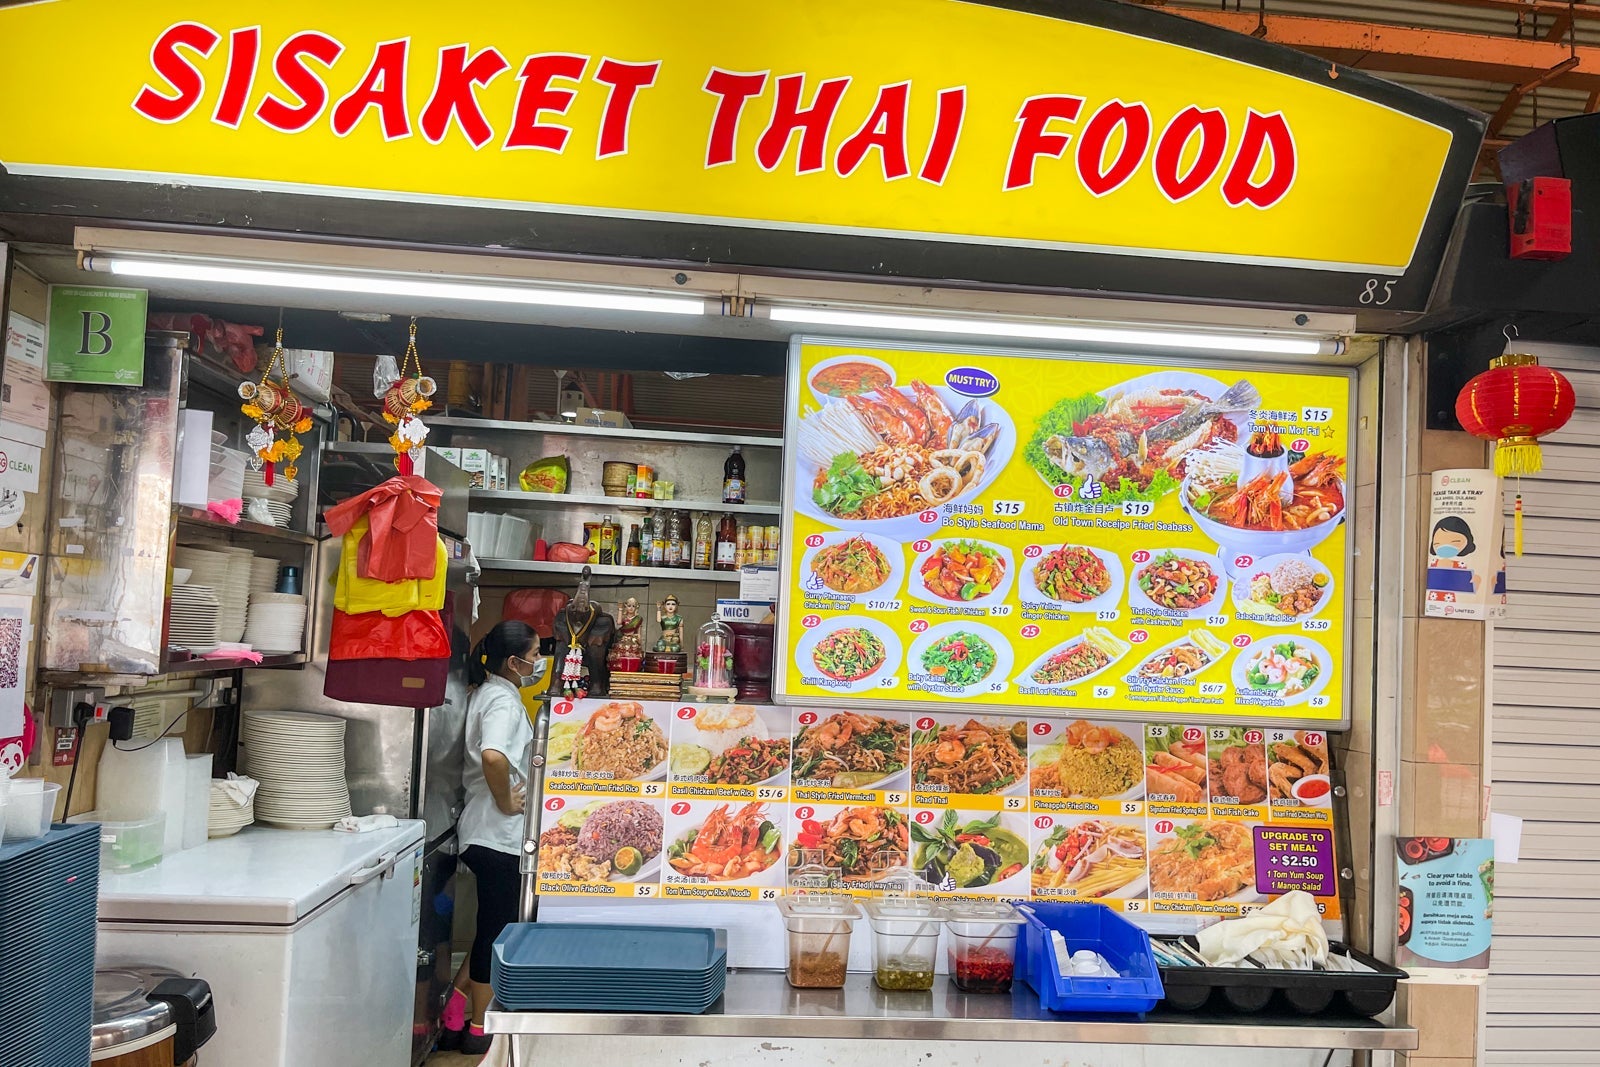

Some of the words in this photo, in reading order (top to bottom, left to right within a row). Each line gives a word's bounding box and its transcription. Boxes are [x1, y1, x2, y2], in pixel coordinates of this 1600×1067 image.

[133, 21, 662, 159] SISAKET
[702, 68, 966, 185] THAI
[1003, 94, 1298, 210] FOOD
[1358, 278, 1397, 305] 85
[75, 310, 113, 356] B
[948, 374, 974, 385] MUST
[975, 378, 995, 388] TRY!
[1304, 409, 1328, 421] $15
[1294, 441, 1307, 450] 17
[1057, 486, 1069, 496] 16
[943, 503, 983, 514] 海鲜妈妈
[994, 502, 1020, 514] $15
[1124, 503, 1150, 515] $19
[922, 512, 935, 522] 15
[942, 517, 954, 527] Bo
[957, 518, 978, 529] Style
[981, 519, 1016, 529] Seafood
[1018, 521, 1045, 531] Mama
[1053, 517, 1068, 526] Old
[1070, 517, 1094, 527] Town
[1096, 519, 1130, 530] Receipe
[1132, 521, 1154, 530] Fried
[1157, 522, 1193, 532] Seabass
[809, 536, 821, 546] 18
[916, 542, 929, 551] 19
[1027, 547, 1039, 556] 20
[1134, 552, 1146, 561] 21
[1237, 557, 1250, 567] 22
[804, 601, 830, 610] Chicken
[834, 602, 850, 610] Beef
[868, 600, 900, 610] $10/12
[1021, 601, 1040, 611] Spicy
[1040, 602, 1063, 611] Yellow
[723, 607, 749, 617] MICO
[991, 606, 1008, 615] $10
[1099, 611, 1116, 620] $10
[1131, 607, 1146, 615] Thai
[1146, 607, 1163, 617] Style
[1163, 608, 1189, 618] Chicken
[1021, 611, 1043, 621] Ginger
[1043, 612, 1070, 621] Chicken
[1208, 616, 1225, 625] $10
[804, 617, 818, 627] 23
[911, 622, 926, 631] 24
[1304, 620, 1327, 629] $5.50
[1024, 627, 1037, 636] 25
[1130, 632, 1146, 642] 26
[1235, 636, 1250, 647] 27
[881, 678, 893, 686] $6
[990, 683, 1002, 691] $6
[922, 683, 944, 692] Oyster
[944, 685, 965, 693] Sauce
[1018, 686, 1036, 695] Basil
[1036, 687, 1050, 695] Leaf
[1051, 688, 1078, 697] Chicken
[1097, 688, 1108, 696] $6
[1202, 684, 1223, 693] $6/7
[1312, 697, 1324, 705] $8
[560, 703, 567, 713] 1
[681, 710, 690, 719] 2
[803, 714, 812, 724] 3
[921, 719, 929, 729] 4
[1038, 724, 1046, 734] 5
[1151, 727, 1163, 736] $5
[1186, 730, 1199, 740] 12
[1213, 730, 1224, 738] $5
[1247, 732, 1259, 742] 13
[1273, 733, 1284, 741] $8
[1307, 735, 1320, 745] 14
[549, 782, 574, 791] Seafood
[578, 783, 593, 791] Tom
[594, 783, 607, 791] Yum
[608, 784, 625, 793] Fried
[625, 784, 639, 793] Rice
[645, 785, 657, 794] $5
[672, 786, 688, 795] Basil
[689, 787, 714, 796] Chicken
[718, 788, 734, 796] Beef
[740, 789, 754, 797] Rice
[796, 791, 810, 799] Thai
[810, 791, 827, 801] Style
[828, 792, 844, 800] Fried
[845, 793, 876, 801] Vermicelli
[889, 794, 900, 802] $5
[915, 795, 932, 804] Phad
[933, 796, 948, 804] Thai
[549, 800, 559, 810] 6
[1008, 799, 1019, 807] $5
[1034, 800, 1066, 811] Pineapple
[1066, 801, 1083, 810] Fried
[1084, 802, 1099, 811] Rice
[1125, 803, 1136, 812] $5
[676, 805, 685, 815] 7
[800, 808, 809, 818] 8
[1212, 807, 1227, 815] Thai
[1227, 808, 1242, 816] Fish
[920, 812, 929, 820] 9
[1037, 818, 1050, 828] 10
[1157, 823, 1170, 832] 11
[1261, 832, 1309, 841] UPGRADE
[1311, 834, 1325, 842] TO
[1269, 843, 1288, 851] SET
[1290, 843, 1318, 852] MEAL
[1270, 856, 1278, 864] +
[1281, 855, 1318, 867] $2.50
[1267, 870, 1271, 878] 1
[1273, 870, 1288, 879] Tom
[1289, 871, 1304, 879] Yum
[1305, 871, 1324, 881] Soup
[540, 883, 560, 892] Black
[561, 884, 579, 892] Olive
[580, 884, 599, 892] Fried
[600, 885, 615, 893] Rice
[1276, 882, 1300, 890] Mango
[1302, 882, 1322, 890] Salad
[638, 887, 651, 896] $5
[666, 887, 678, 895] Tom
[678, 887, 692, 895] Yum
[692, 888, 708, 897] Soup
[714, 889, 727, 897] Rice
[763, 890, 775, 899] $6
[1128, 902, 1139, 911] $5
[1154, 902, 1171, 911] Mince
[1171, 903, 1193, 912] Chicken
[1196, 904, 1213, 913] Prawn
